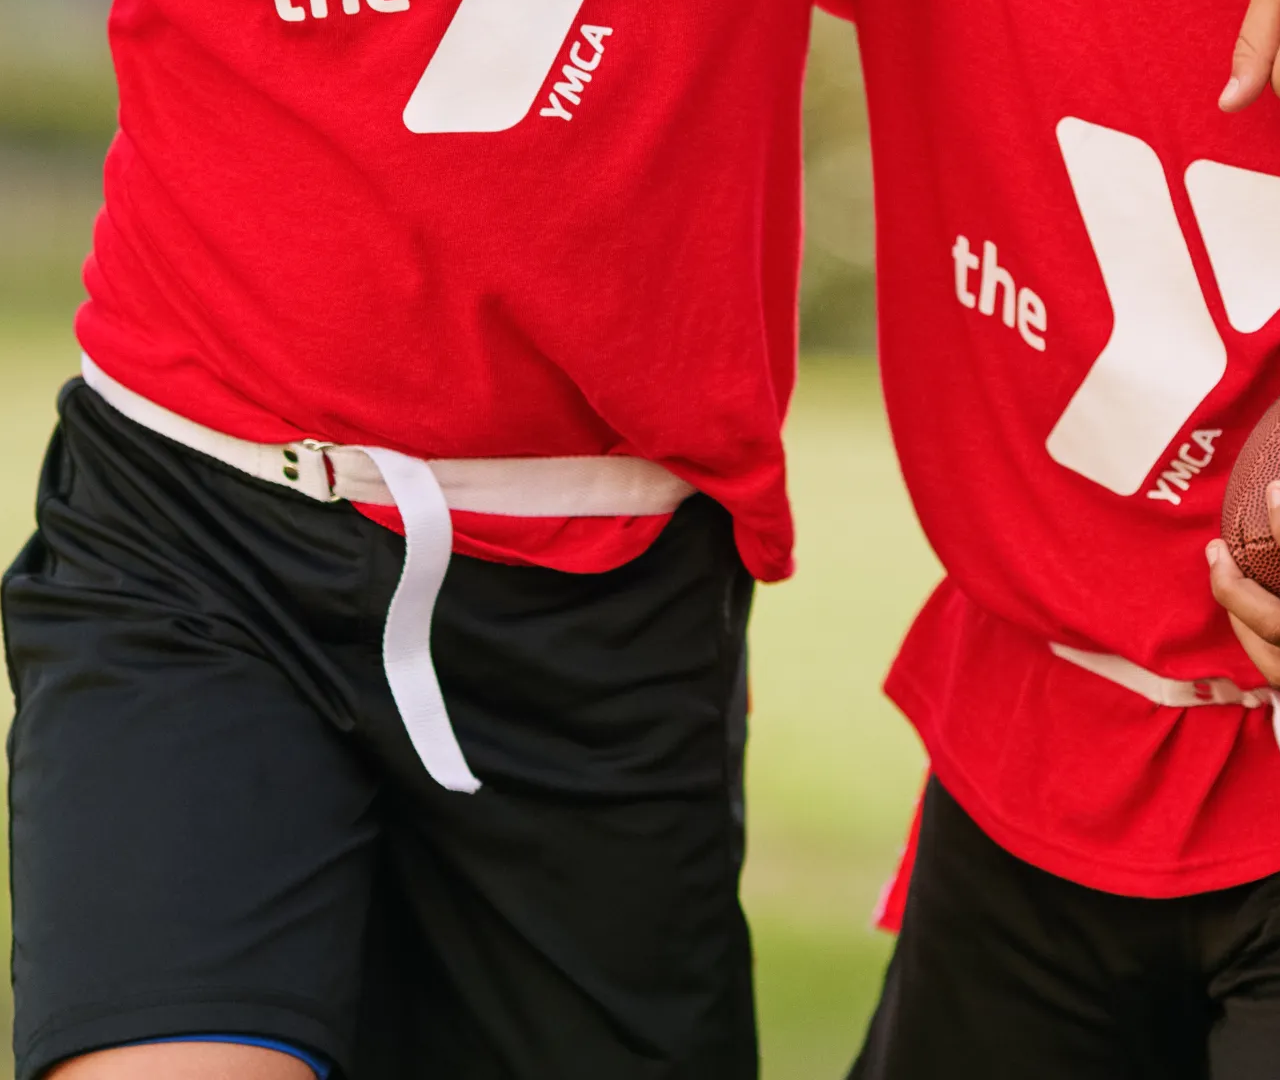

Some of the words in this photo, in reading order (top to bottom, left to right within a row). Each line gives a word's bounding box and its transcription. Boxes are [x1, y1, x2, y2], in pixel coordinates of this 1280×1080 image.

[539, 23, 614, 122] YMCA
[951, 234, 1048, 352] the
[1147, 428, 1223, 506] YMCA
